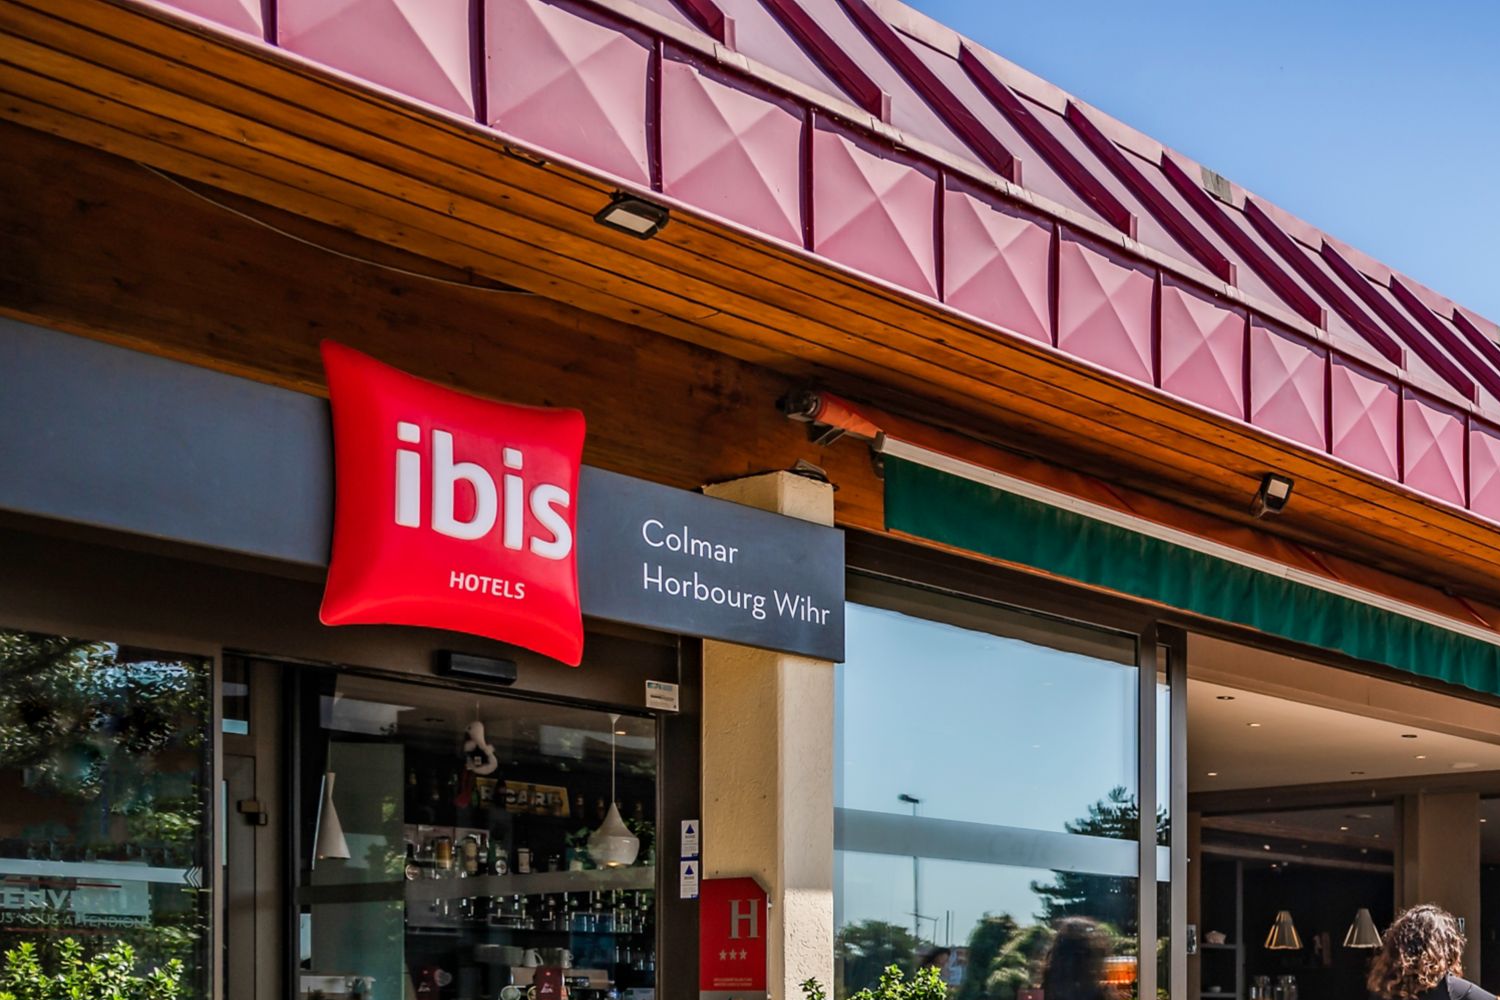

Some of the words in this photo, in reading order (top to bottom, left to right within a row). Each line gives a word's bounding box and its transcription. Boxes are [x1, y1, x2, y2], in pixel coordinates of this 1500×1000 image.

[395, 421, 573, 560] ibis
[642, 519, 738, 563] Colmar
[449, 571, 525, 600] HOTELS
[643, 562, 766, 620] Horbourg
[773, 590, 830, 625] Wihr
[728, 899, 761, 939] H
